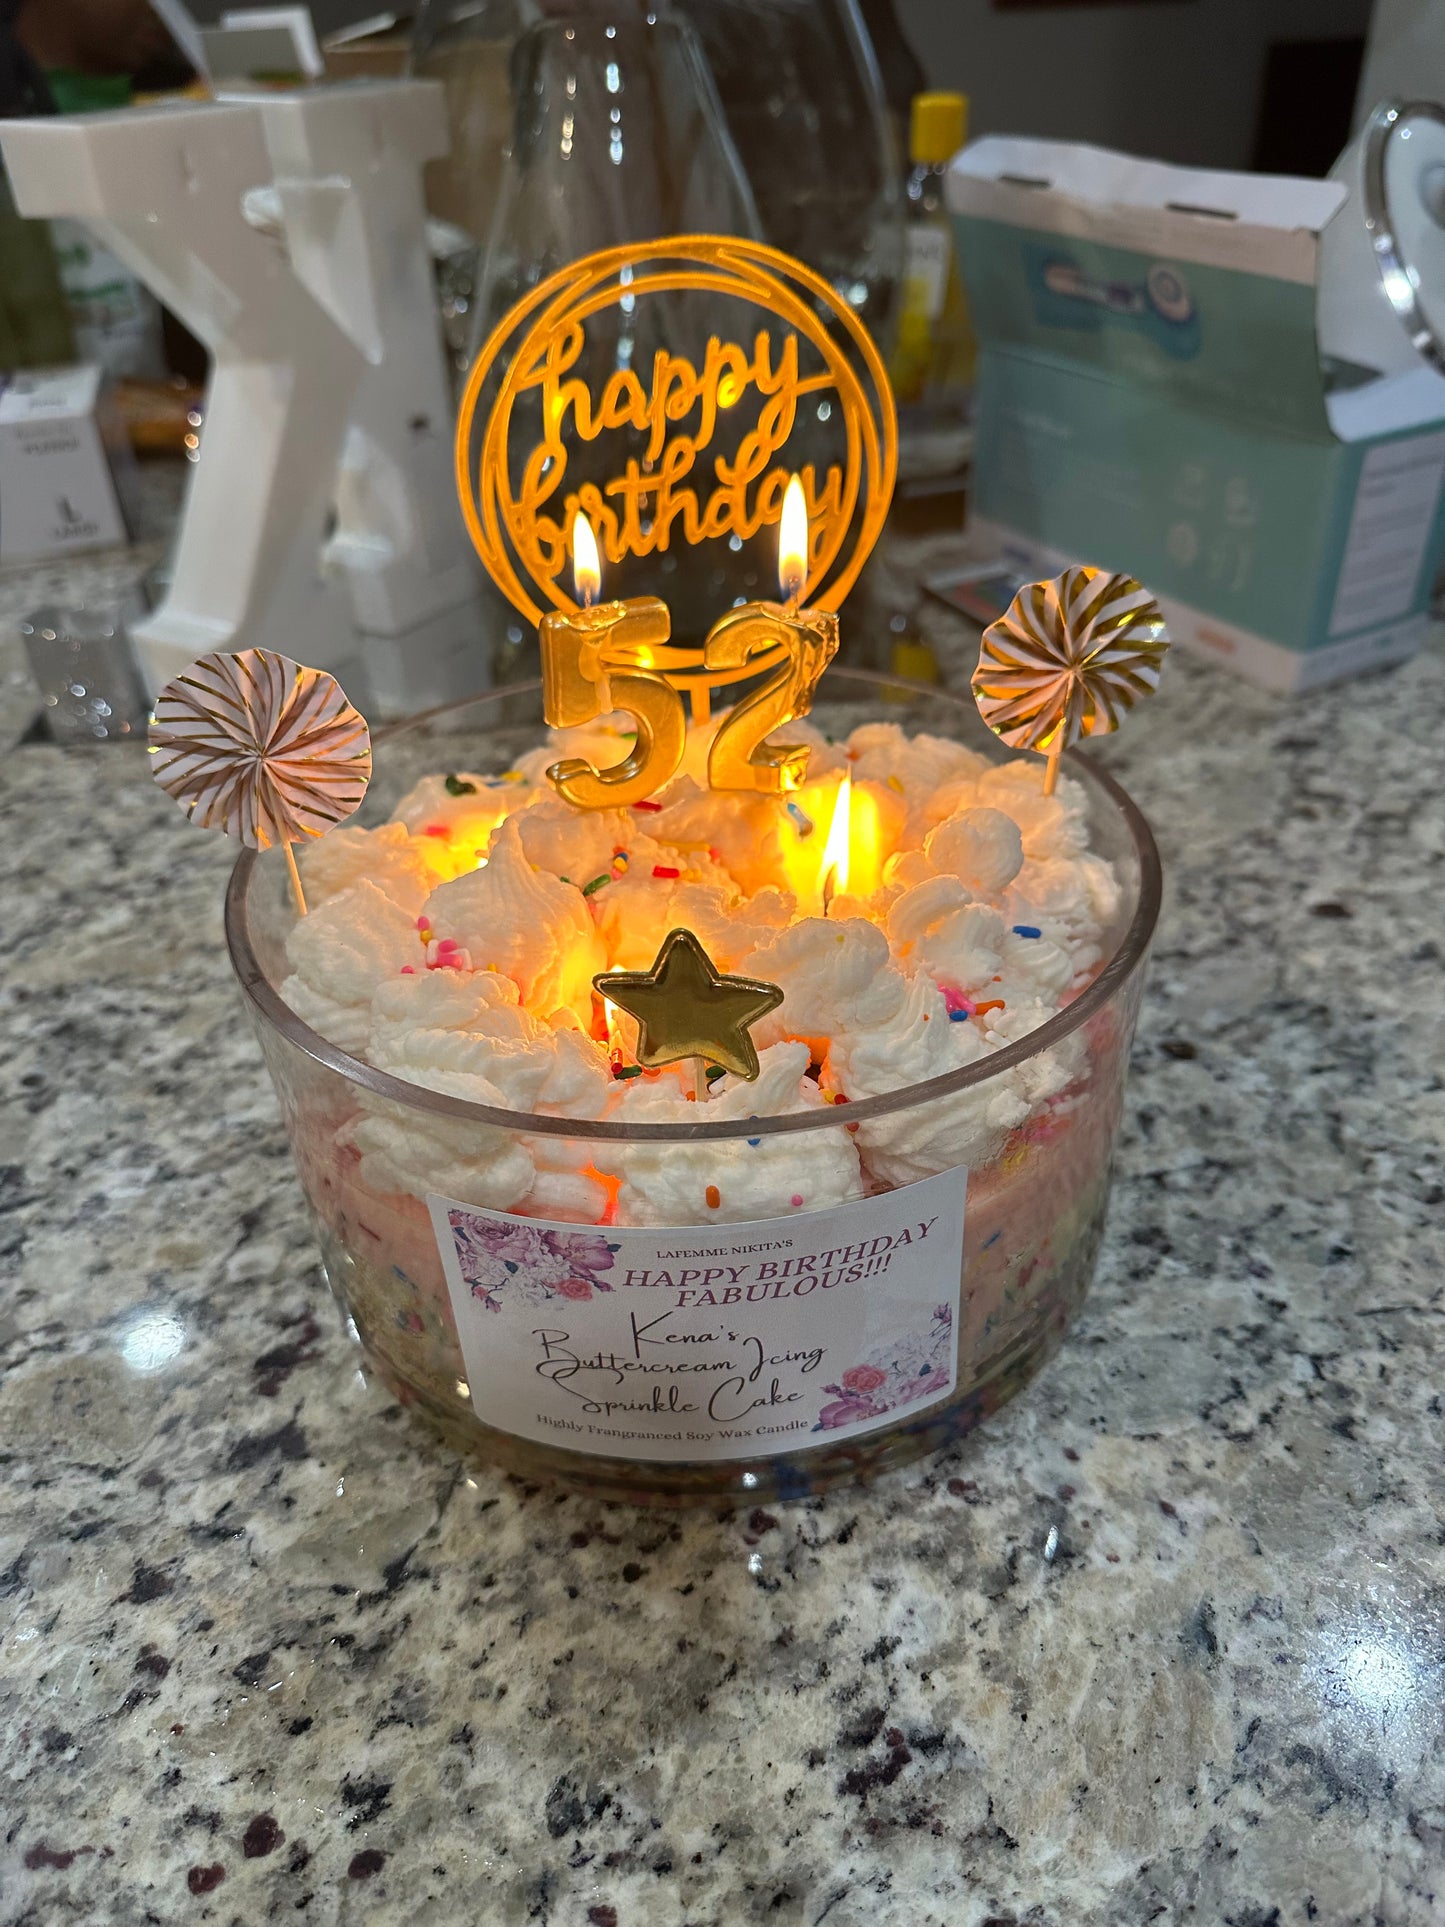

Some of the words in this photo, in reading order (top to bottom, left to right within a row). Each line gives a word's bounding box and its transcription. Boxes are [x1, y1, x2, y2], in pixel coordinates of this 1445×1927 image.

[514, 320, 832, 463] happy
[622, 1265, 750, 1287] HAPPY
[756, 1216, 939, 1281] BIRTHDAY
[657, 1246, 728, 1259] LAFEMME
[732, 1239, 793, 1254] NIKITA'S
[674, 1253, 892, 1308] FABULOUS!!!
[532, 1328, 738, 1385] Buttercream
[630, 1311, 740, 1358] Kena's
[551, 1367, 701, 1417] Sprinkle
[708, 1376, 806, 1422] Cake
[536, 1414, 584, 1433] Highly
[588, 1424, 682, 1441] Frangranced
[686, 1431, 714, 1441] Soy
[719, 1428, 751, 1440] Wax
[756, 1418, 809, 1436] Candle
